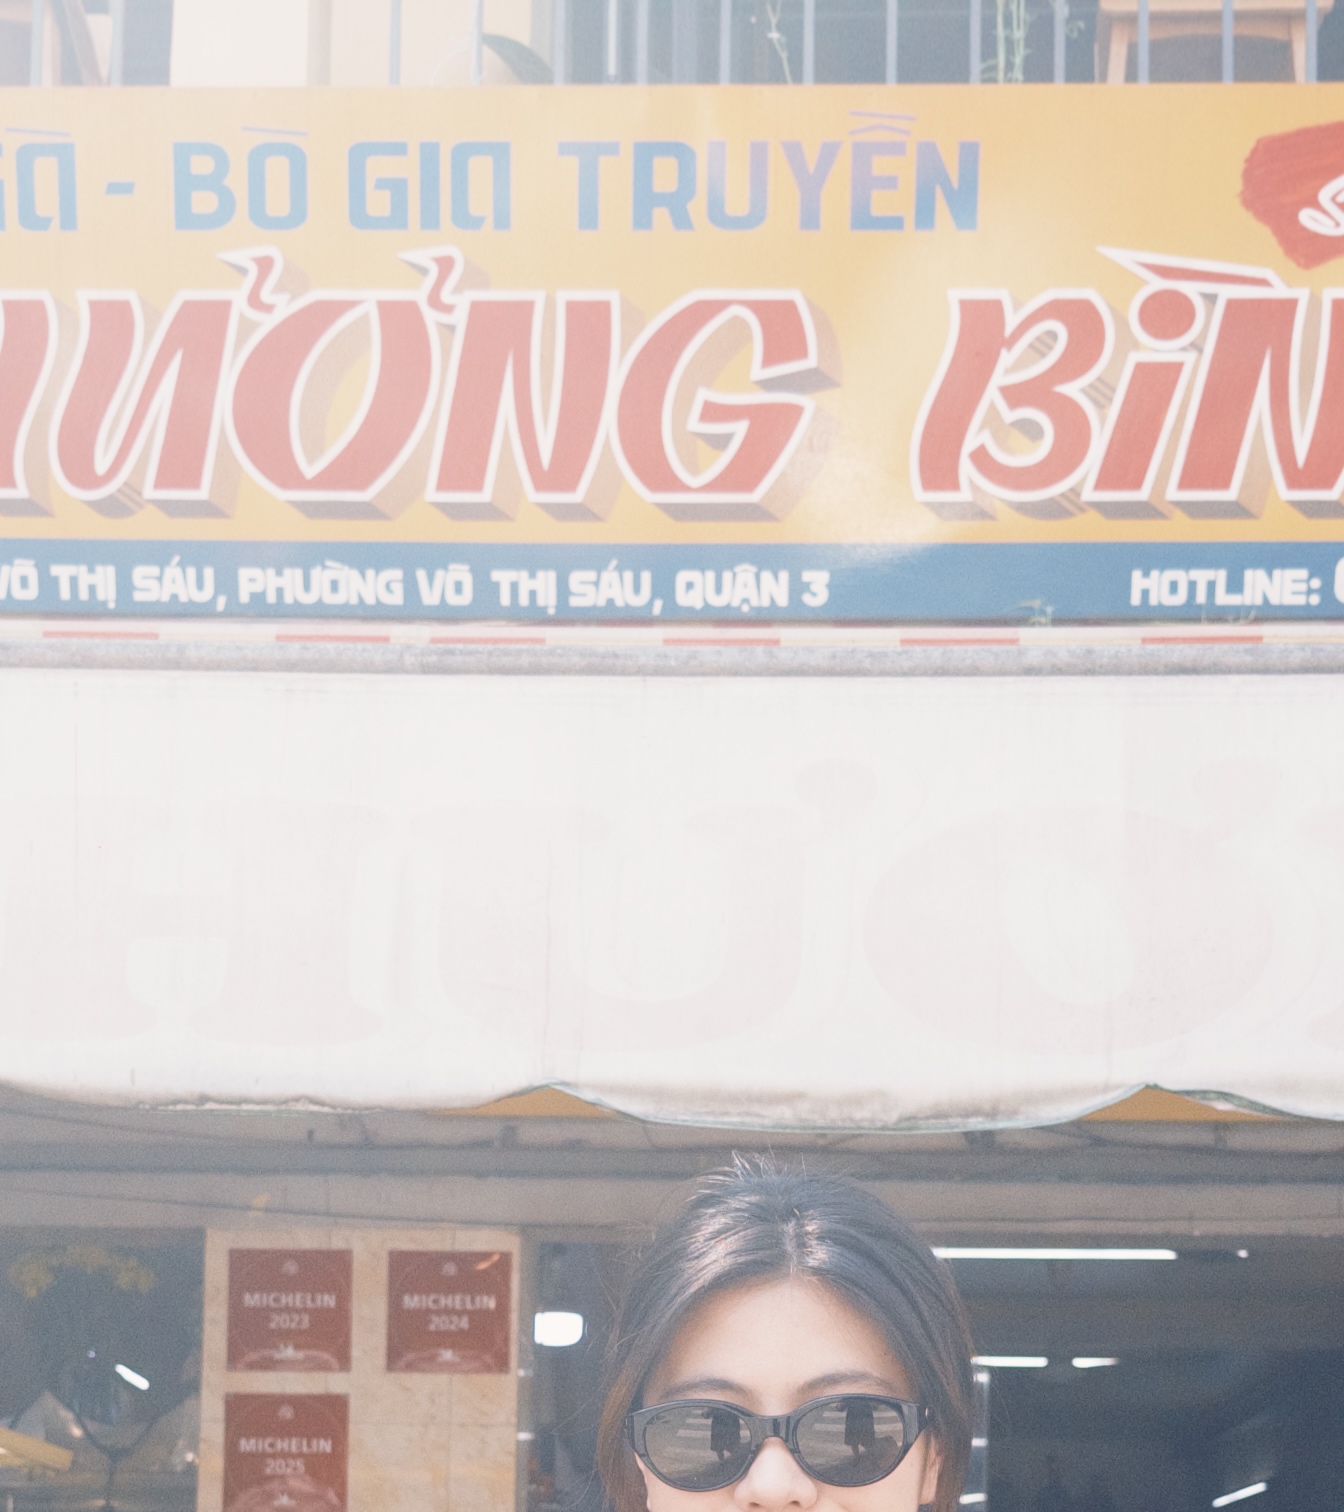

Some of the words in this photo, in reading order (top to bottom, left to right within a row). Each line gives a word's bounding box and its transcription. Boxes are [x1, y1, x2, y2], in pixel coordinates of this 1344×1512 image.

[172, 125, 309, 232] BÒ
[348, 140, 512, 232] GIA
[558, 111, 981, 232] TRUYỀN
[49, 564, 116, 609] THỊ
[131, 555, 228, 613] SÁU,
[237, 559, 404, 607] PHƯỜNG
[416, 562, 473, 607] VÕ
[490, 569, 557, 615] THỊ
[567, 558, 664, 616] SÁU,
[674, 563, 790, 613] QUẬN
[800, 569, 831, 607] 3
[1130, 568, 1322, 607] HOTLINE:
[243, 1290, 337, 1309] MICHELIN
[402, 1293, 497, 1311] MICHELIN
[269, 1312, 310, 1330] 2023
[428, 1315, 470, 1332] 2024
[239, 1436, 333, 1454] MICHELIN
